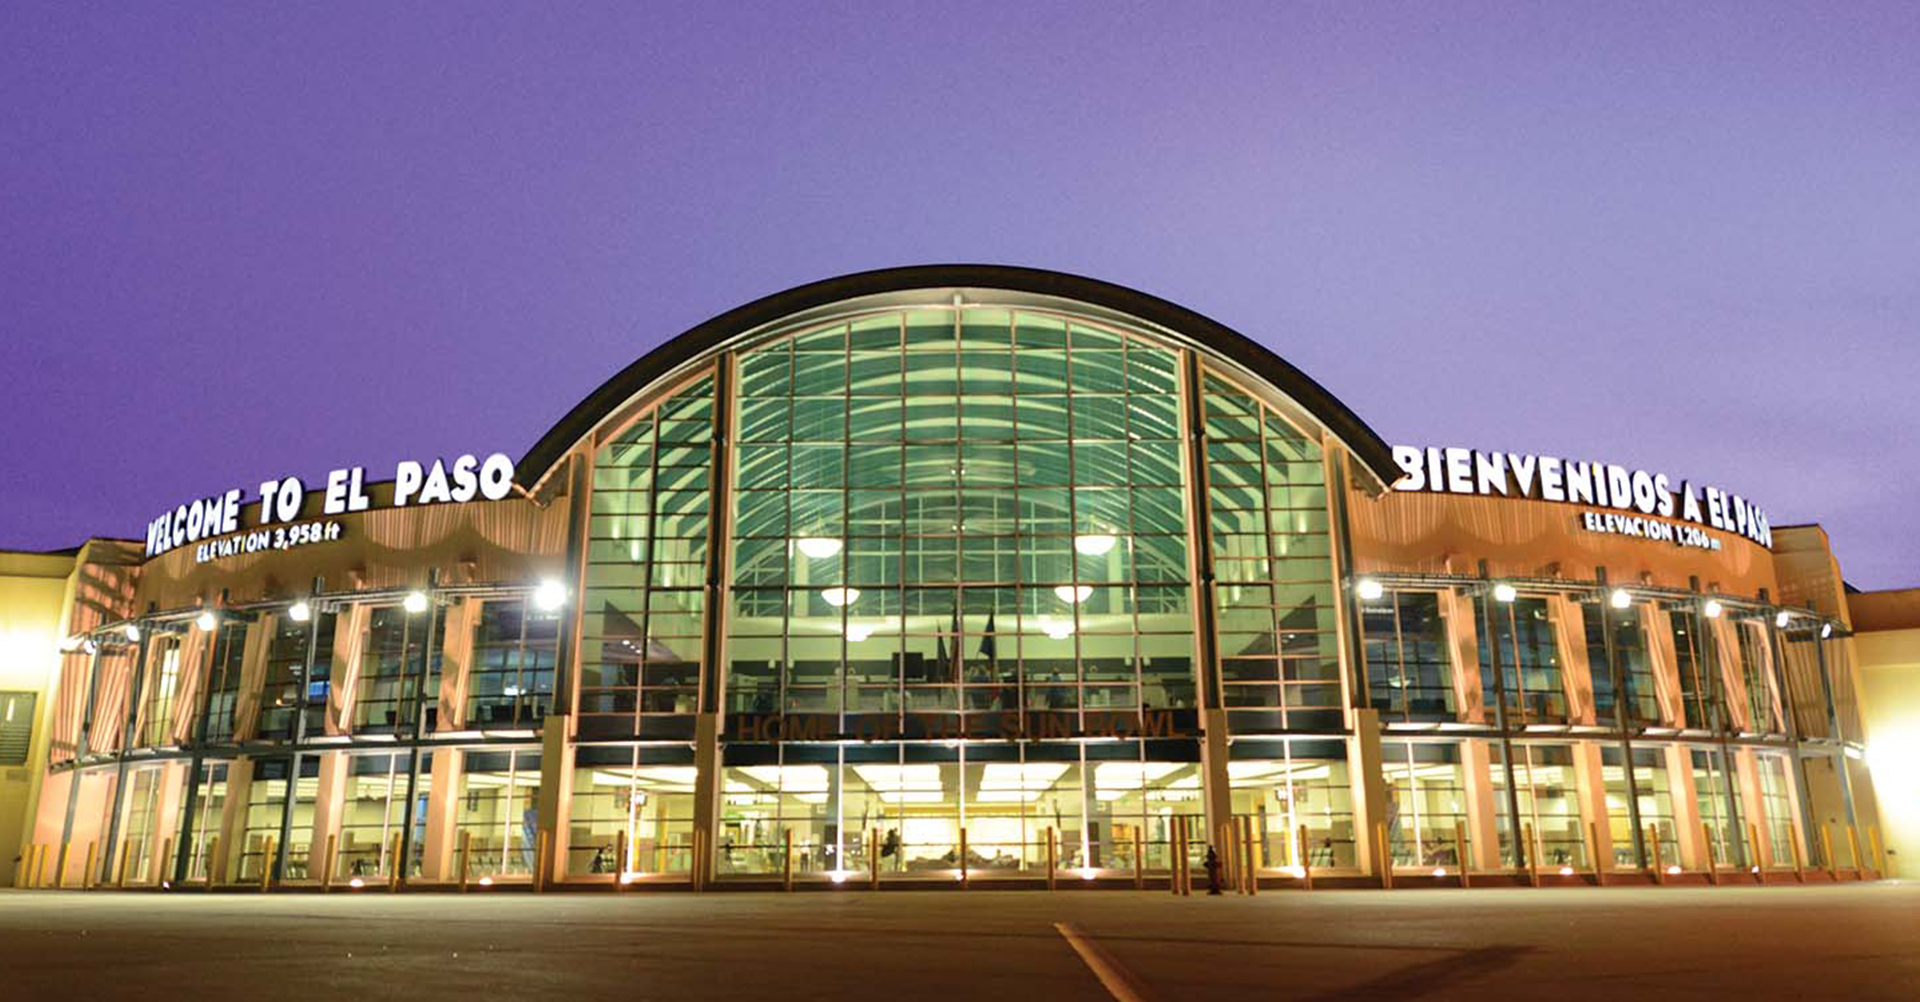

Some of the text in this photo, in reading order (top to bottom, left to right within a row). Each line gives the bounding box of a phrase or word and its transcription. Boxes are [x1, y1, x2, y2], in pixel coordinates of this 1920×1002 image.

[146, 453, 515, 558] WELCOME TO EL PASO
[1393, 446, 1773, 549] BIENVENIDOS A EL PASO
[196, 520, 340, 563] ELEVATION 3,958 ft
[1584, 512, 1674, 542] ELEVACION
[737, 713, 836, 744] HOME
[855, 713, 903, 744] OF
[999, 710, 1071, 744] SUN
[1086, 709, 1187, 742] BOWL
